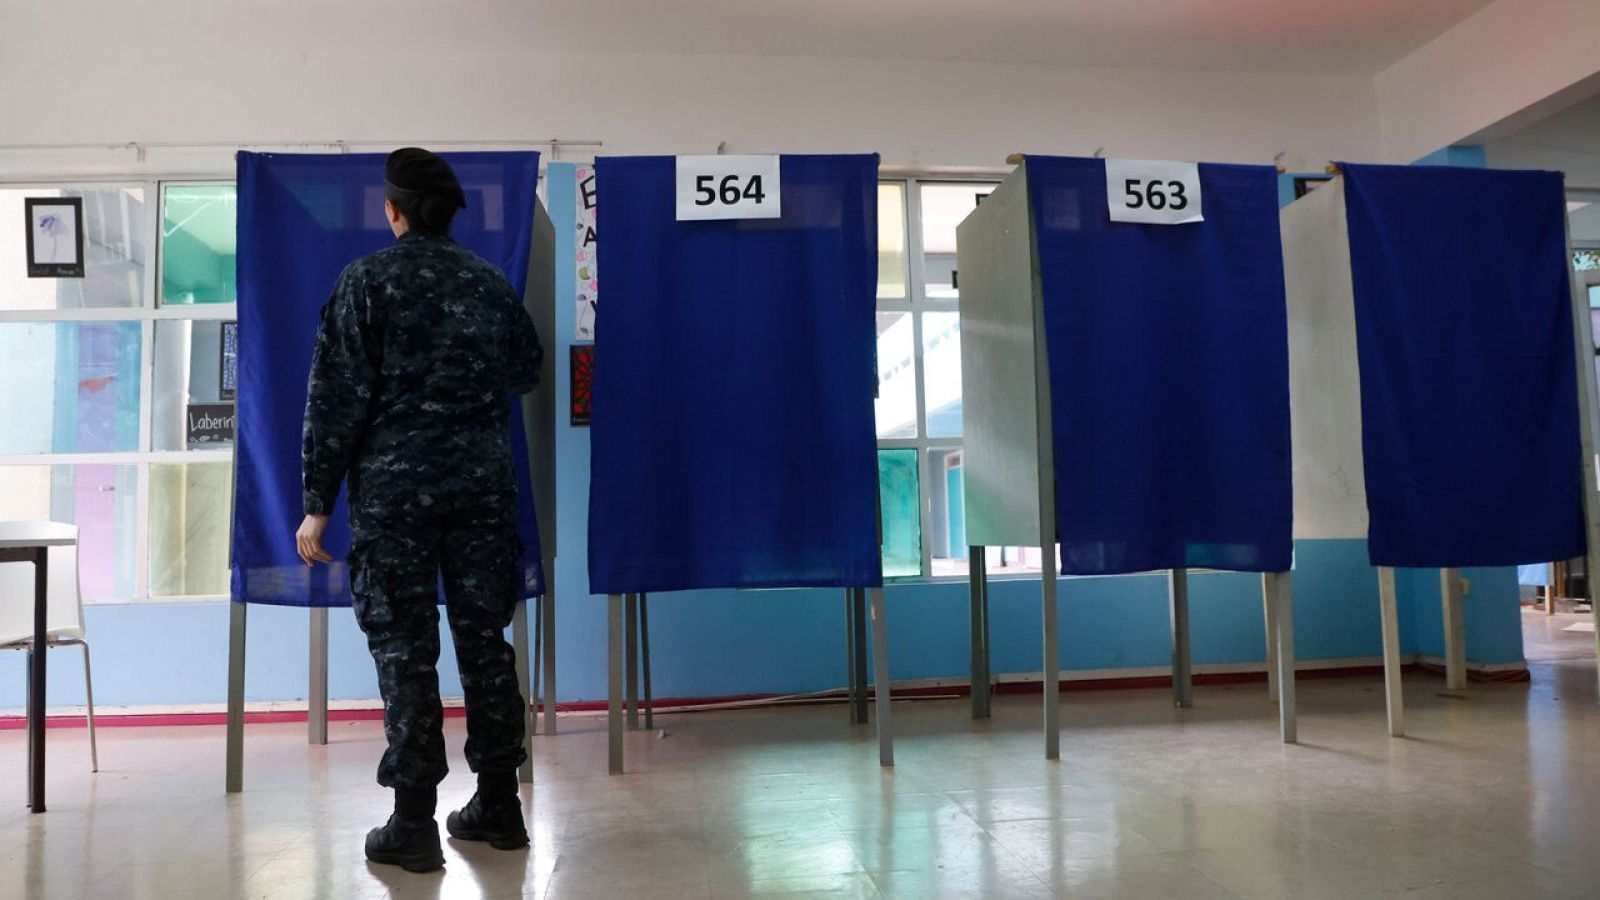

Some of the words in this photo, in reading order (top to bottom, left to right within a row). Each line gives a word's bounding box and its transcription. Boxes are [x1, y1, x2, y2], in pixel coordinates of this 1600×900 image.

[695, 174, 766, 206] 564
[1125, 179, 1188, 210] 563
[189, 412, 235, 432] Laberin
